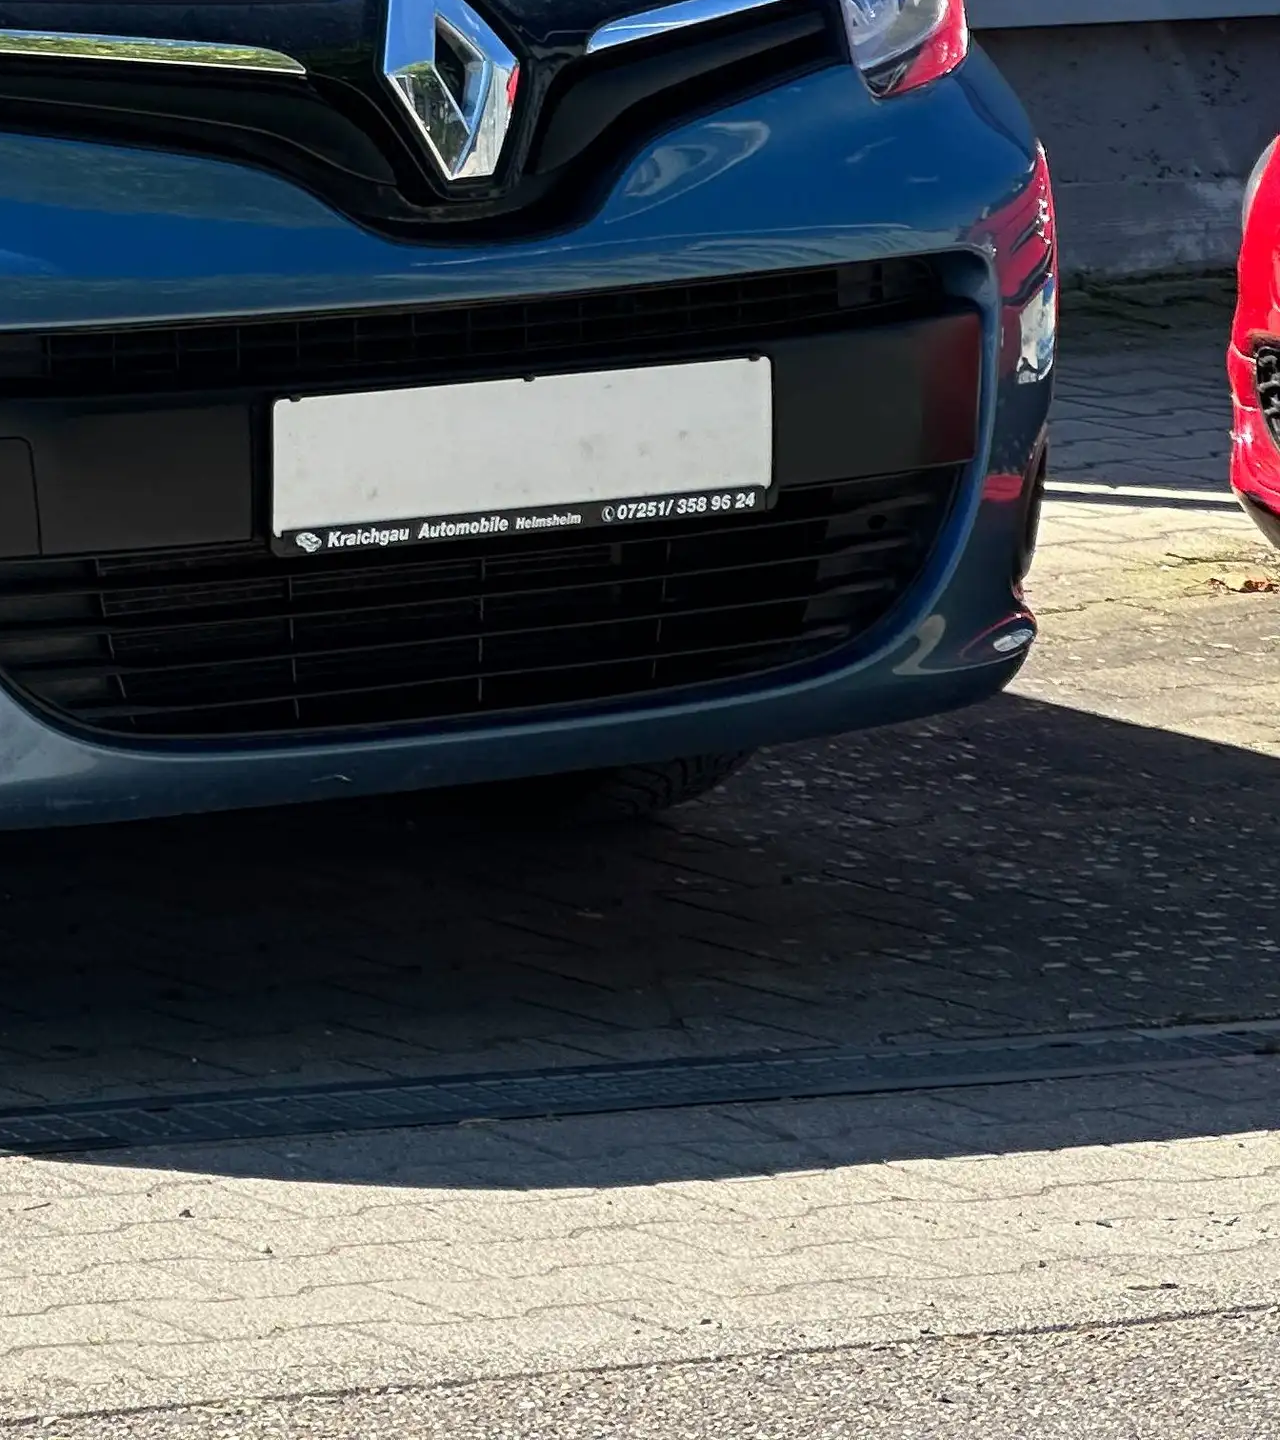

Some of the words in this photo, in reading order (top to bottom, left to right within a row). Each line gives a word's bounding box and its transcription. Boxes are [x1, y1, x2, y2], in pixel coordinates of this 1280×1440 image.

[326, 526, 410, 548] Kraichgau
[417, 515, 509, 540] Automobile
[676, 496, 708, 515] 358
[710, 493, 732, 512] 96
[734, 491, 756, 509] 24
